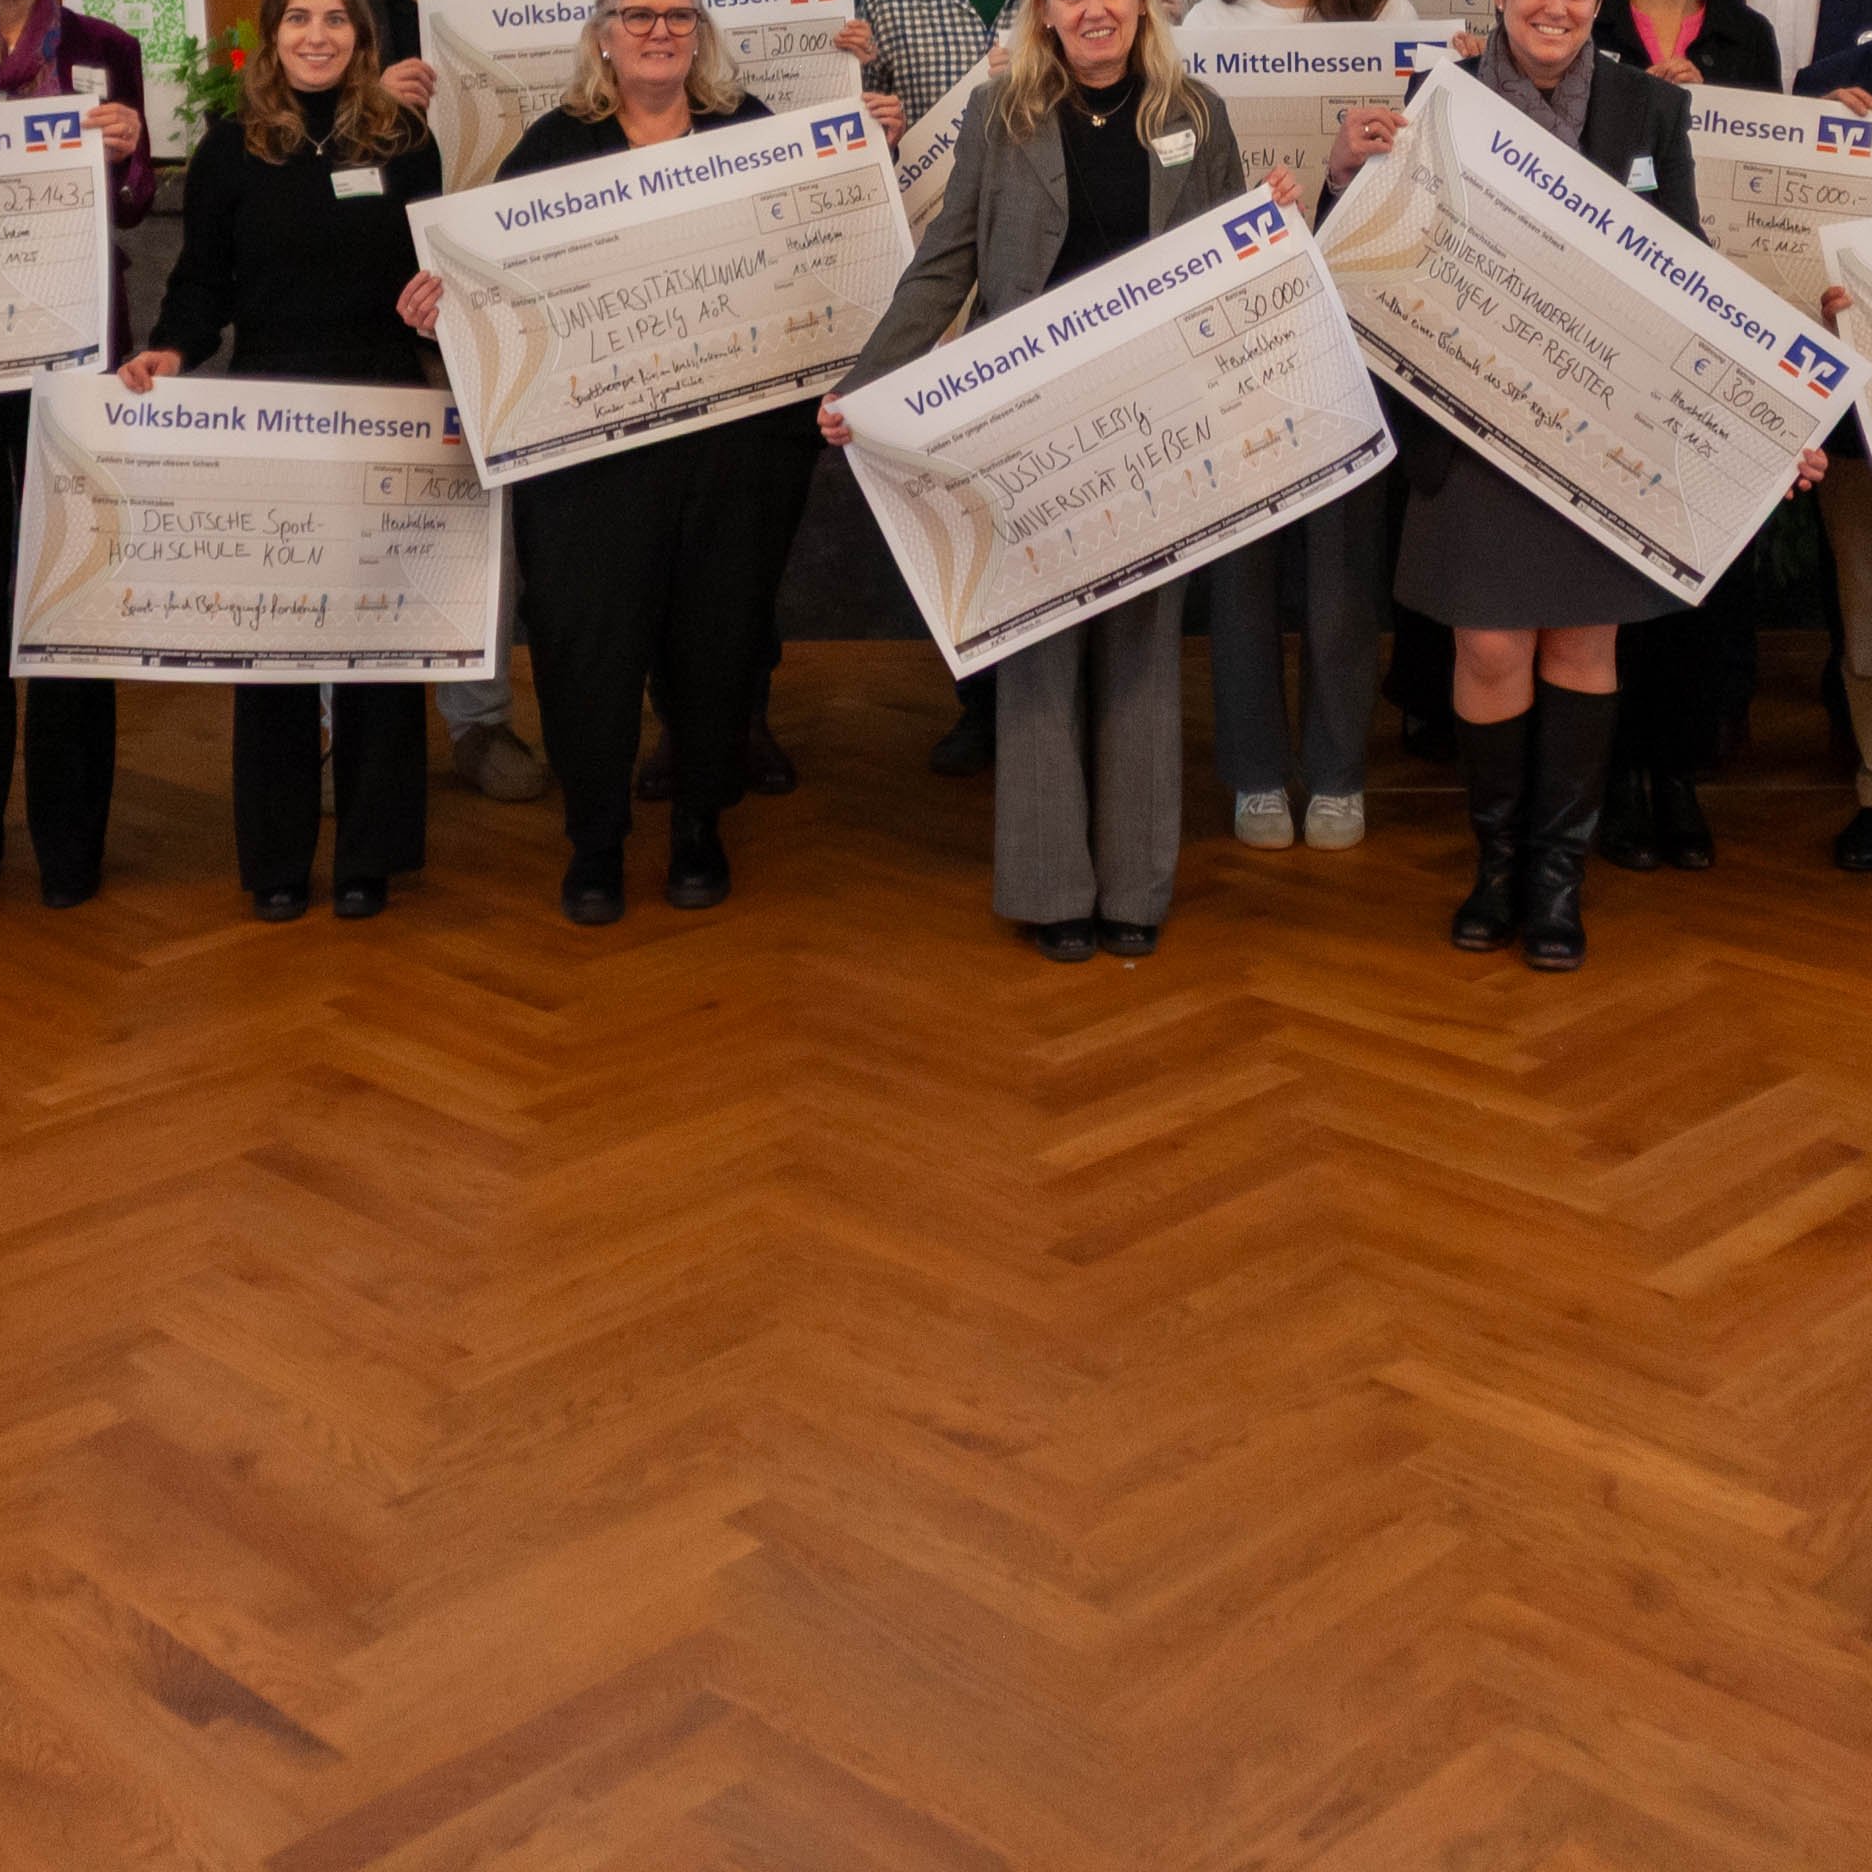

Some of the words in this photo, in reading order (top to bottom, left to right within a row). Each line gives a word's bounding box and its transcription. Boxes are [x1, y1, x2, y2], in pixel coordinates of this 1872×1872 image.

[739, 38, 752, 55] €
[1216, 51, 1383, 75] Mittelhessen
[495, 178, 634, 233] Volksbank
[638, 139, 805, 197] Mittelhessen
[1748, 176, 1763, 194] €
[770, 201, 785, 221] €
[1489, 128, 1614, 236] Volksbank
[1618, 225, 1778, 352] Mittelhessen
[545, 249, 770, 339] UNIVERSITÄTSKLINIKUM
[1415, 244, 1499, 318] TÜBINGEN
[589, 307, 689, 364] LEIPZIG
[904, 334, 1047, 417] Volksbank
[1045, 244, 1224, 351] Mittelhessen
[1198, 318, 1216, 339] €
[1693, 357, 1711, 377] €
[104, 402, 246, 433] Volksbank
[256, 407, 432, 441] Mittelhessen
[379, 475, 394, 495] €
[142, 509, 256, 534] DEUTSCHE
[990, 468, 1117, 546] UNIVERSITÄT
[107, 537, 252, 567] HOCHSCHULE
[262, 538, 325, 568] KÖLN
